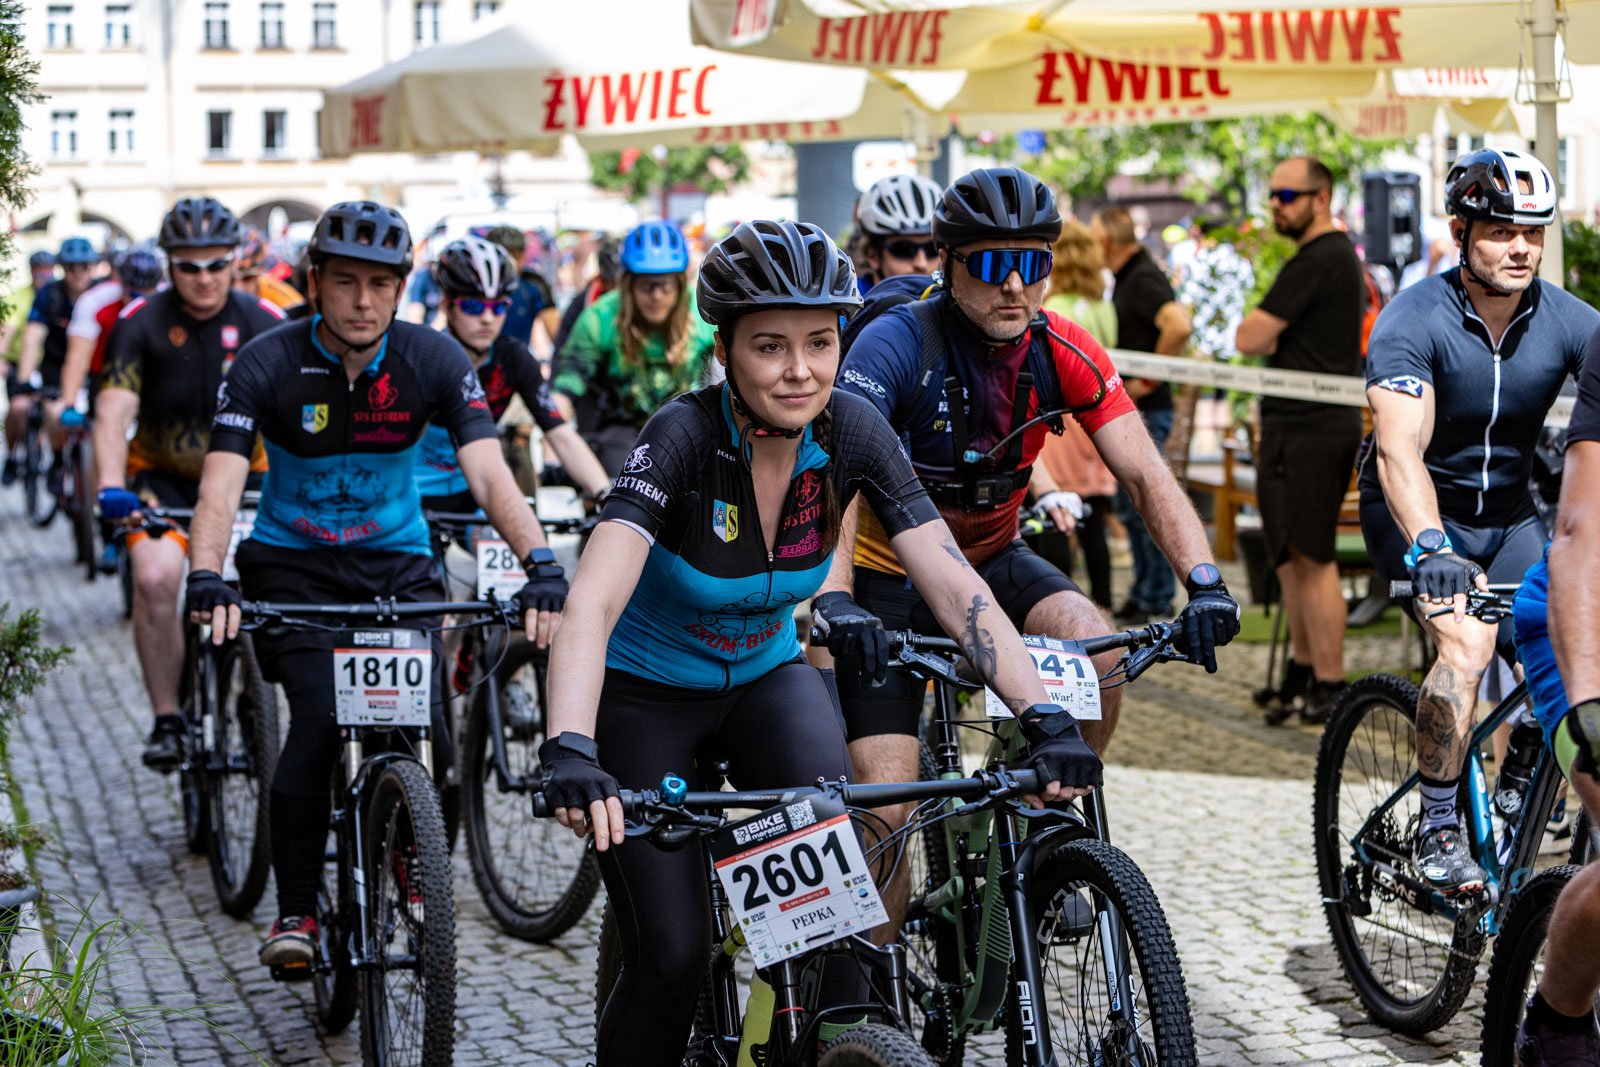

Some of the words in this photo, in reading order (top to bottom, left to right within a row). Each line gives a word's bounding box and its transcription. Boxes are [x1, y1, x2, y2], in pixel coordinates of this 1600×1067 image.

[1034, 45, 1230, 105] ŻYWIEC
[542, 65, 717, 132] ŻYWIEC
[617, 476, 669, 508] EXTREME
[485, 548, 523, 570] 28
[343, 657, 423, 687] 1810
[1029, 653, 1085, 679] 41
[1048, 692, 1074, 702] War!
[748, 812, 785, 834] BIKE
[751, 823, 787, 841] maraton
[732, 830, 852, 911] 2601
[791, 906, 836, 930] PEPKA
